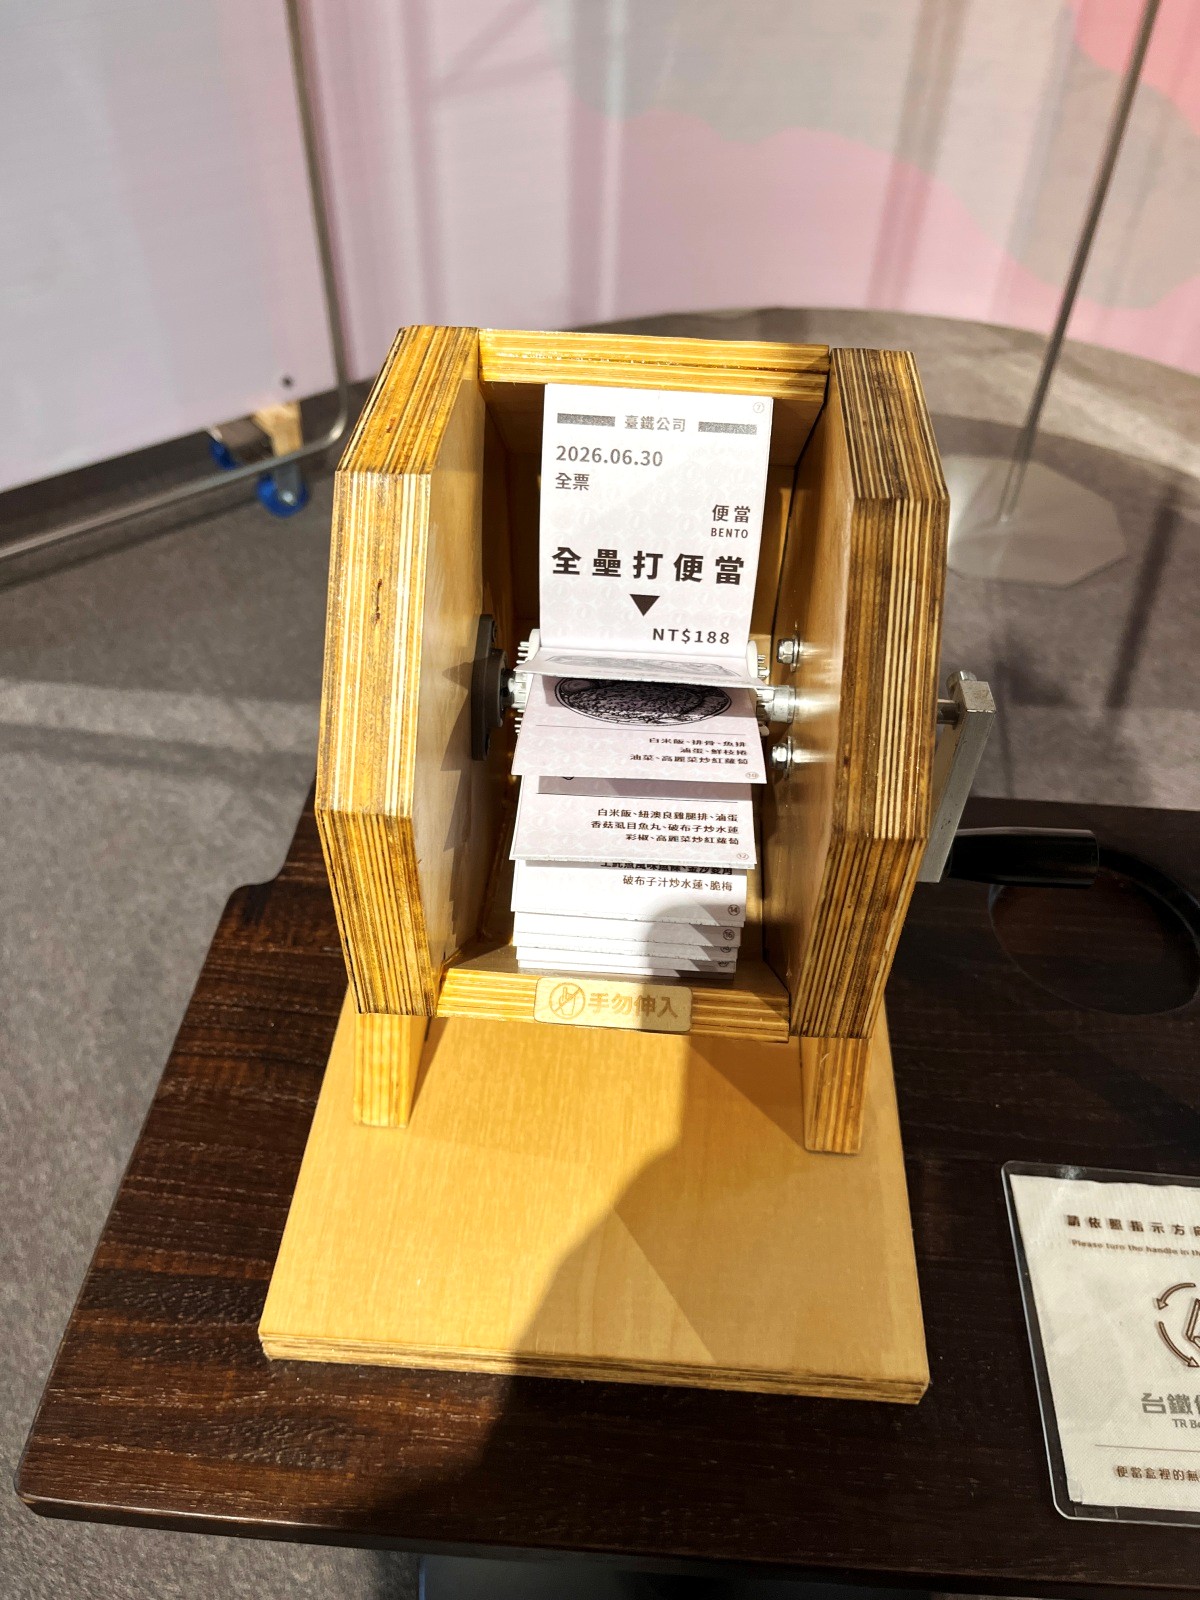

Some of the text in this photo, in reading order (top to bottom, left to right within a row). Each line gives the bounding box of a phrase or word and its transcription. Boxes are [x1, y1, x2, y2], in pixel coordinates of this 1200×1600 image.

[624, 414, 686, 432] 臺鐵公司
[556, 445, 663, 467] 2026.06.30
[555, 472, 590, 490] 全票
[712, 504, 751, 523] 便當
[711, 527, 749, 539] BENTO
[551, 546, 745, 585] 全壘打便當
[652, 627, 730, 645] NT$188
[588, 992, 679, 1020] 手勿伸入
[1071, 1239, 1103, 1249] Please
[1106, 1242, 1126, 1251] turn
[1128, 1244, 1143, 1252] the
[1146, 1245, 1178, 1255] handle
[1172, 1418, 1188, 1428] TR
